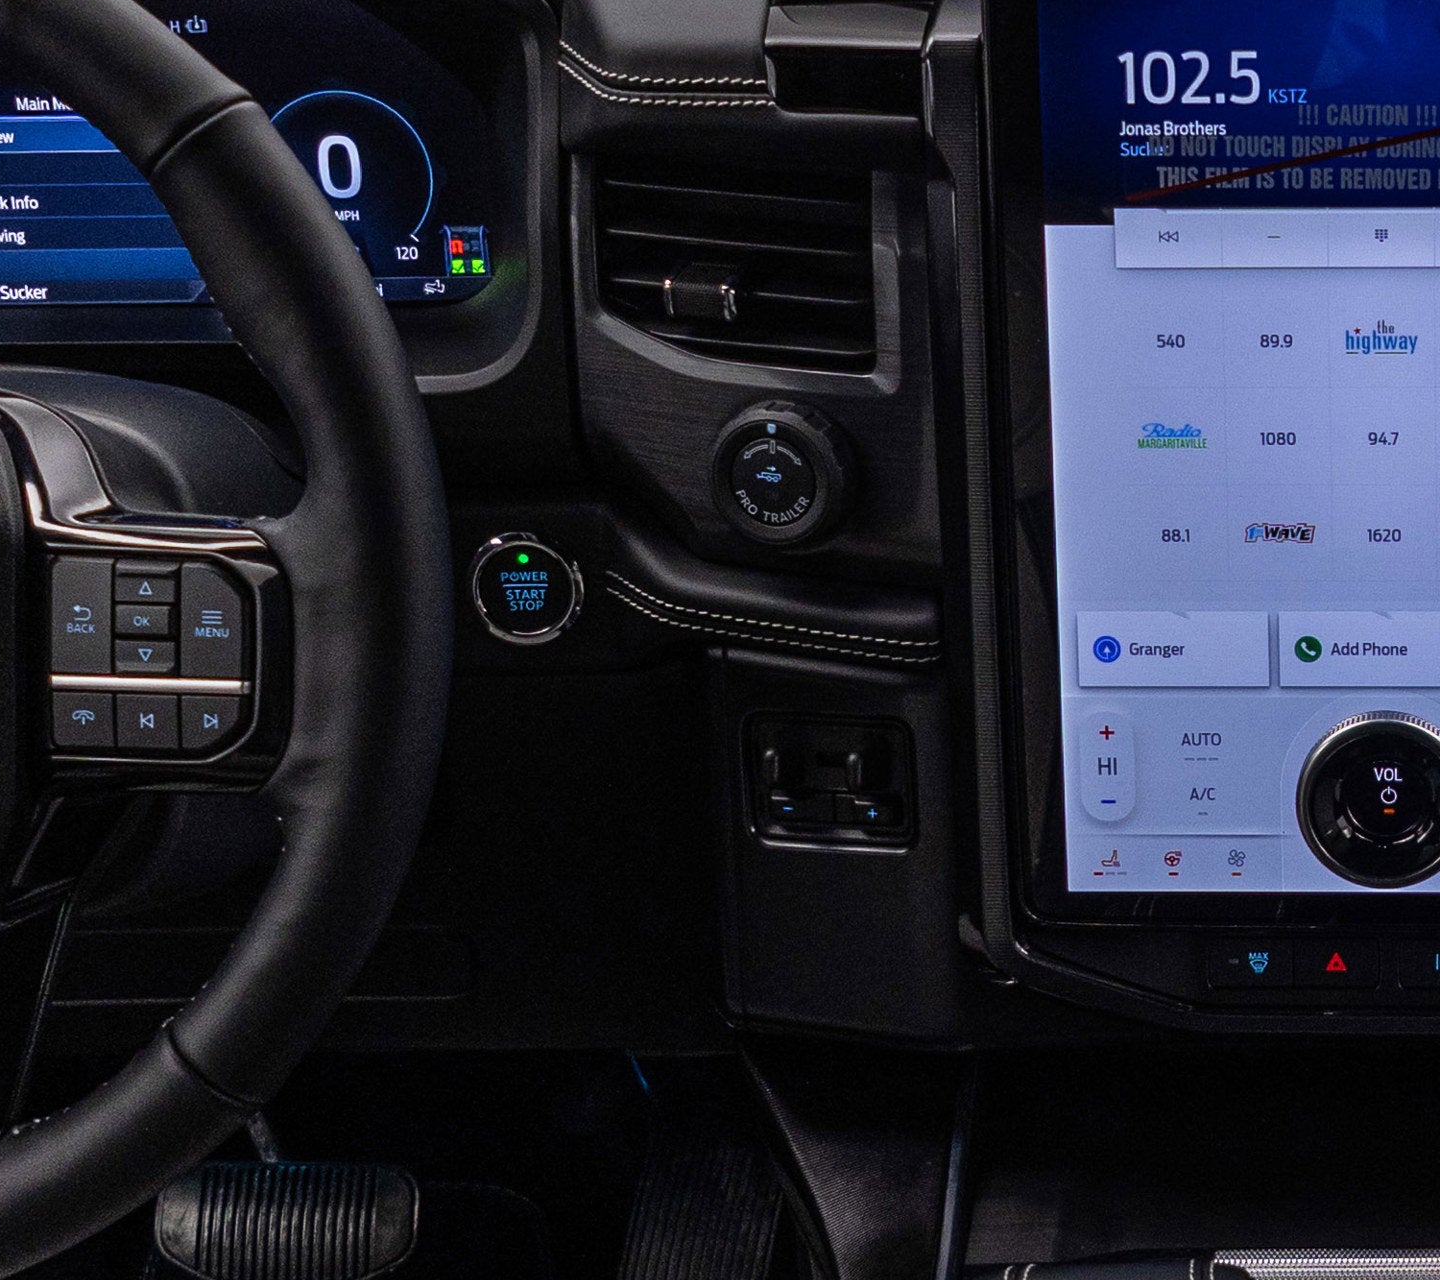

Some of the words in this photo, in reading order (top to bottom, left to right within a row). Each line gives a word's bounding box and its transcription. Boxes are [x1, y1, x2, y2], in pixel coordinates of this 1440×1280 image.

[1118, 50, 1261, 105] 102.5
[1268, 89, 1307, 104] KSTZ
[16, 97, 50, 111] Main
[1327, 105, 1408, 126] CAUTION
[1119, 120, 1161, 136] Jonas
[1163, 120, 1227, 136] Brothers
[1149, 136, 1175, 157] DO
[1181, 136, 1217, 157] NOT
[1223, 135, 1285, 157] TOUCH
[1292, 136, 1369, 158] DISPLAY
[317, 135, 362, 198] 0
[1156, 166, 1199, 188] THIS
[1256, 168, 1275, 189] IS
[1281, 168, 1304, 189] TO
[1310, 168, 1334, 189] BE
[1340, 168, 1431, 190] REMOVED
[11, 196, 38, 210] Info
[334, 210, 359, 221] MPH
[396, 246, 419, 260] 120
[0, 285, 48, 300] Sucker
[1377, 320, 1395, 334] the
[1156, 334, 1185, 348] 540
[1260, 334, 1293, 348] 89.9
[1346, 330, 1418, 354] highway
[1142, 423, 1202, 438] Radio
[1138, 438, 1208, 449] MARGARITAVILLE
[1260, 432, 1296, 445] 1080
[1368, 432, 1399, 446] 94.7
[735, 489, 758, 515] PRO
[762, 496, 810, 524] TRAILER
[1162, 529, 1190, 542] 88.1
[1264, 524, 1312, 541] WAVE
[1367, 529, 1401, 542] 1620
[500, 571, 548, 582] POWER
[505, 589, 546, 600] START
[510, 600, 544, 611] STOP
[133, 616, 150, 626] OK
[66, 624, 95, 633] BACK
[194, 628, 229, 638] MENU
[1129, 643, 1185, 658] Granger
[1331, 643, 1359, 656] Add
[1362, 643, 1408, 656] Phone
[1181, 733, 1222, 747] AUTO
[1098, 757, 1117, 775] HI
[1373, 768, 1402, 782] VOL
[1190, 788, 1216, 801] A/C
